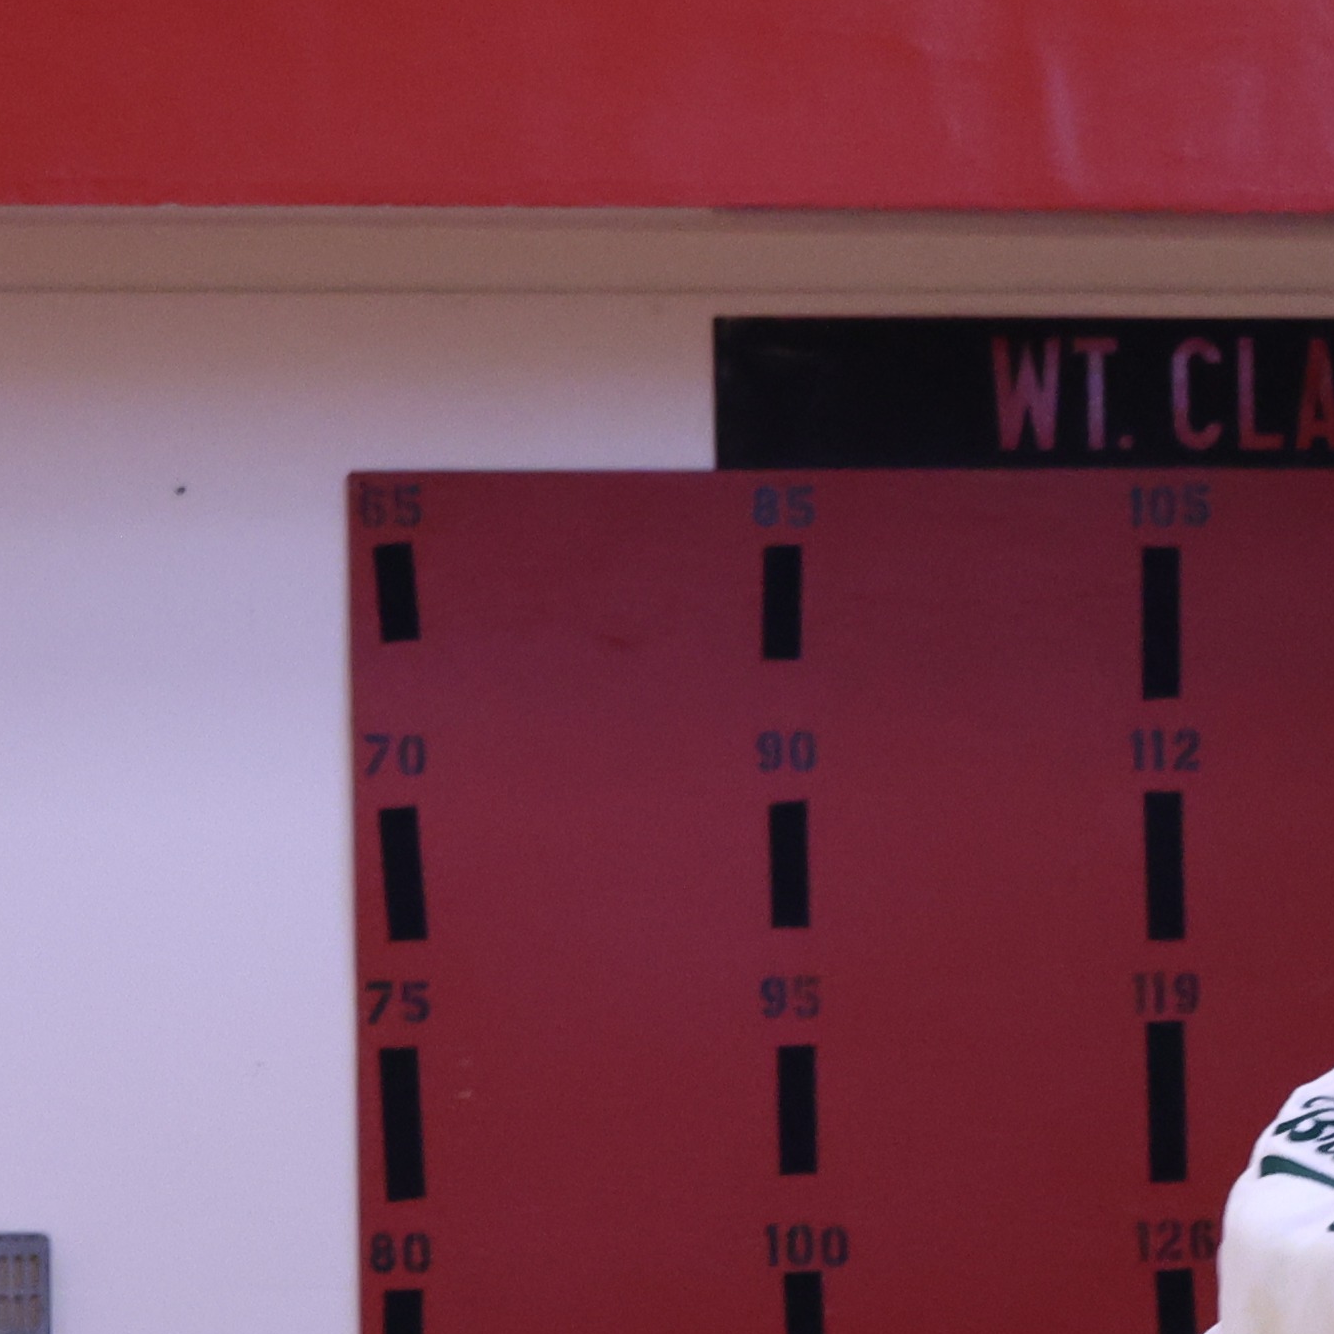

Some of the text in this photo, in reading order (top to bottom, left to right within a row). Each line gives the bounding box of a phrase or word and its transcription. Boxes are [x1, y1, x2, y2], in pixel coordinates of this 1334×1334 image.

[992, 336, 1135, 452] WT.
[359, 484, 422, 528] 65
[752, 485, 817, 528] 85
[1130, 484, 1211, 528] 105
[363, 733, 427, 776] 70
[755, 730, 818, 774] 90
[1130, 728, 1201, 771] 112
[366, 980, 431, 1025] 75
[759, 976, 822, 1019] 95
[1135, 972, 1199, 1015] 119
[369, 1232, 432, 1274] 80
[765, 1224, 848, 1268] 100
[1136, 1219, 1216, 1264] 126
